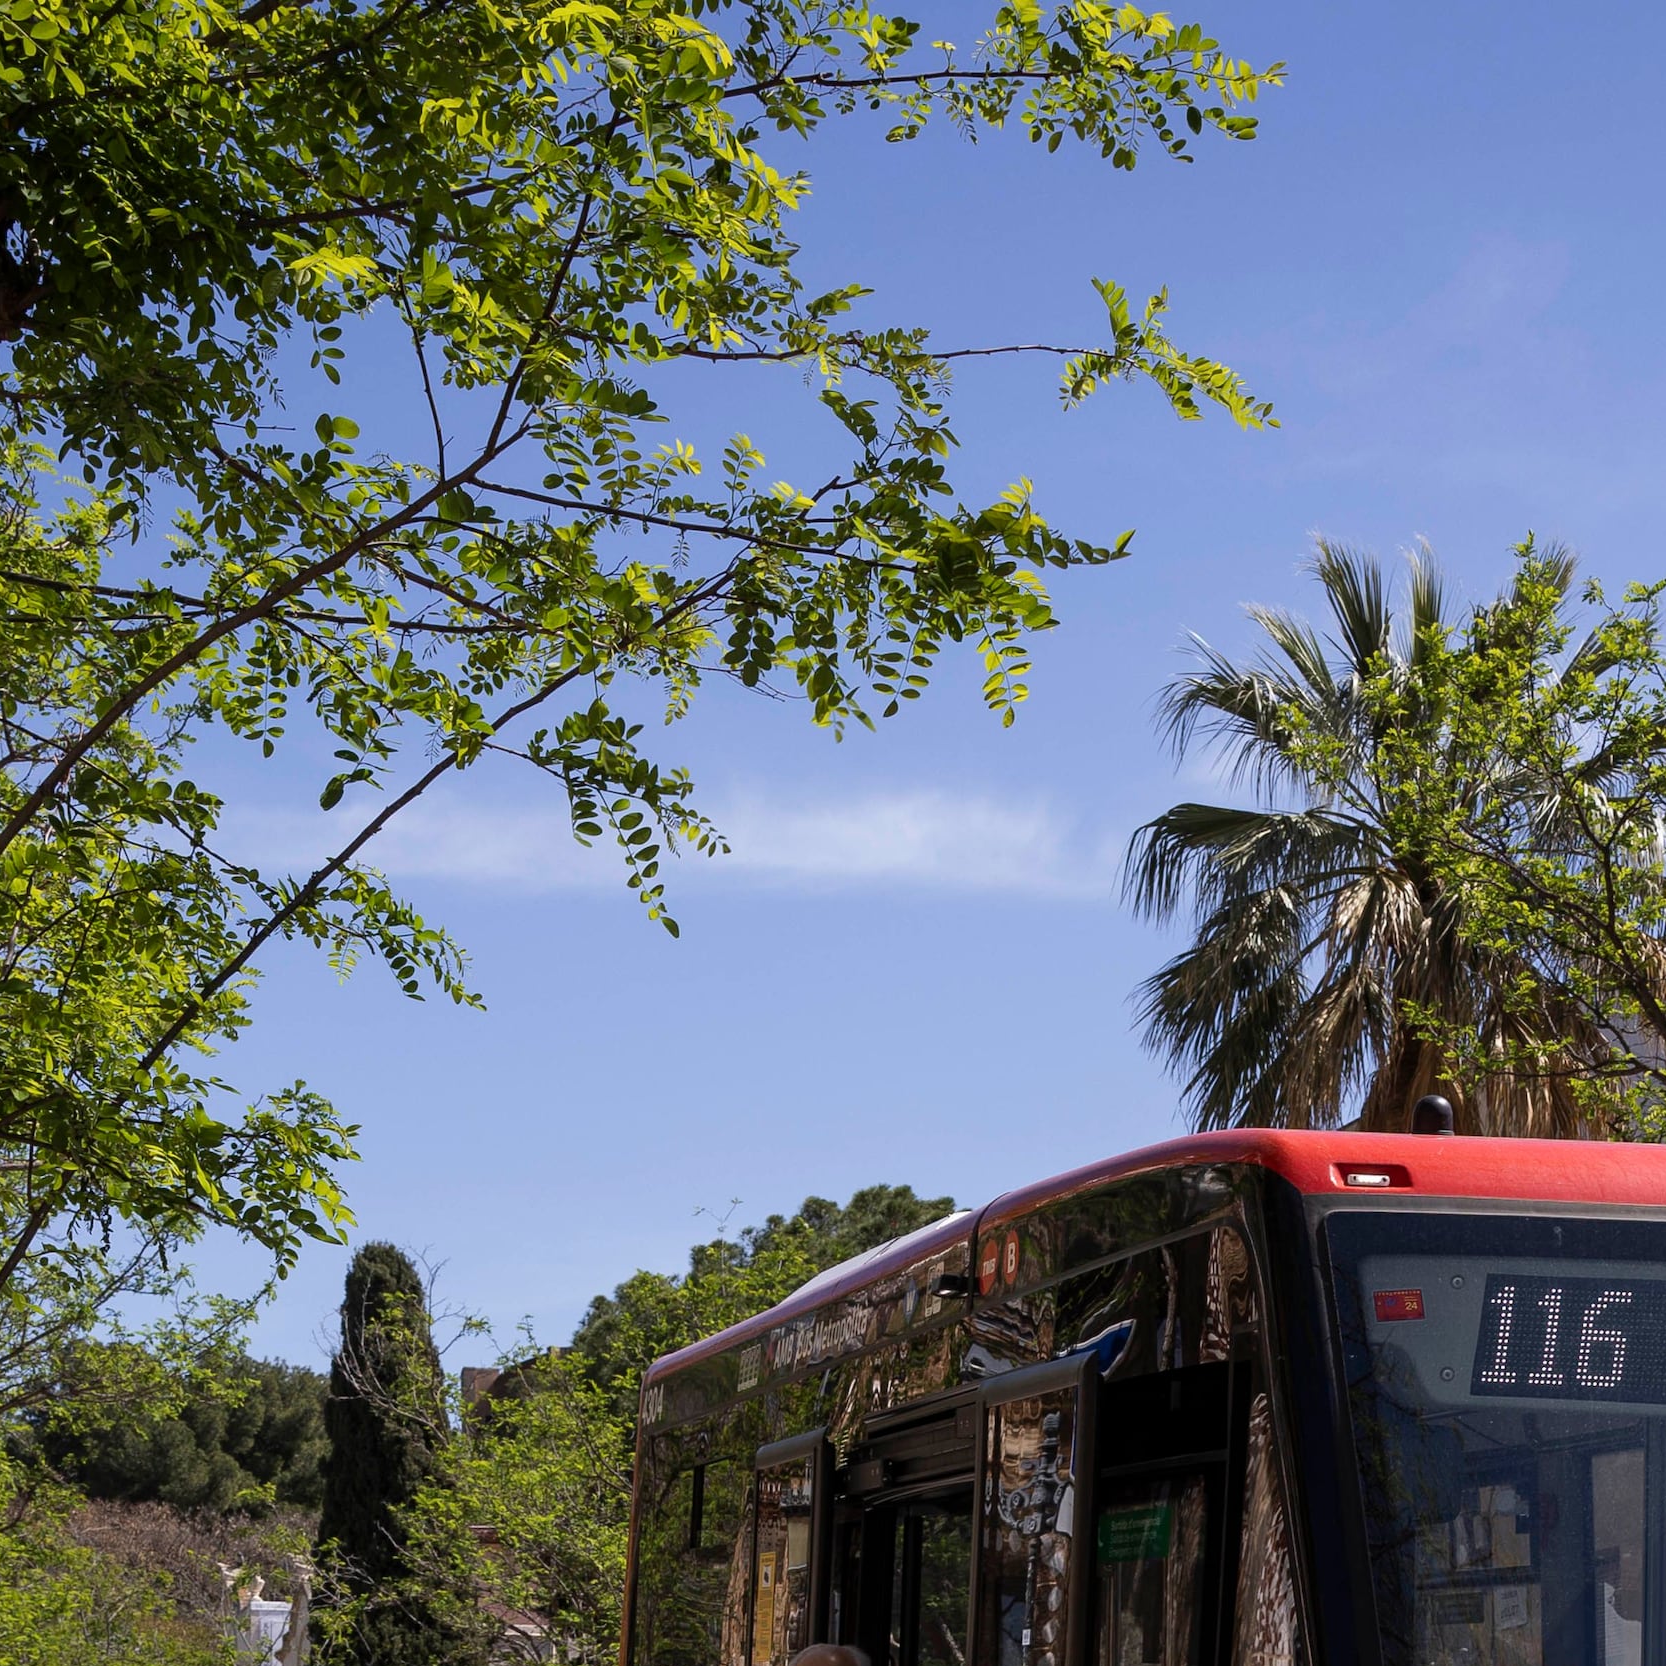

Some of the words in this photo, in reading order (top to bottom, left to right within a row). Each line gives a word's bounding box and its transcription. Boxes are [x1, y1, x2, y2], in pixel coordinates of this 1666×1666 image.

[1007, 1242, 1015, 1274] B
[1405, 1301, 1418, 1311] 24
[1481, 1286, 1633, 1387] 116
[642, 1384, 664, 1426] 4304
